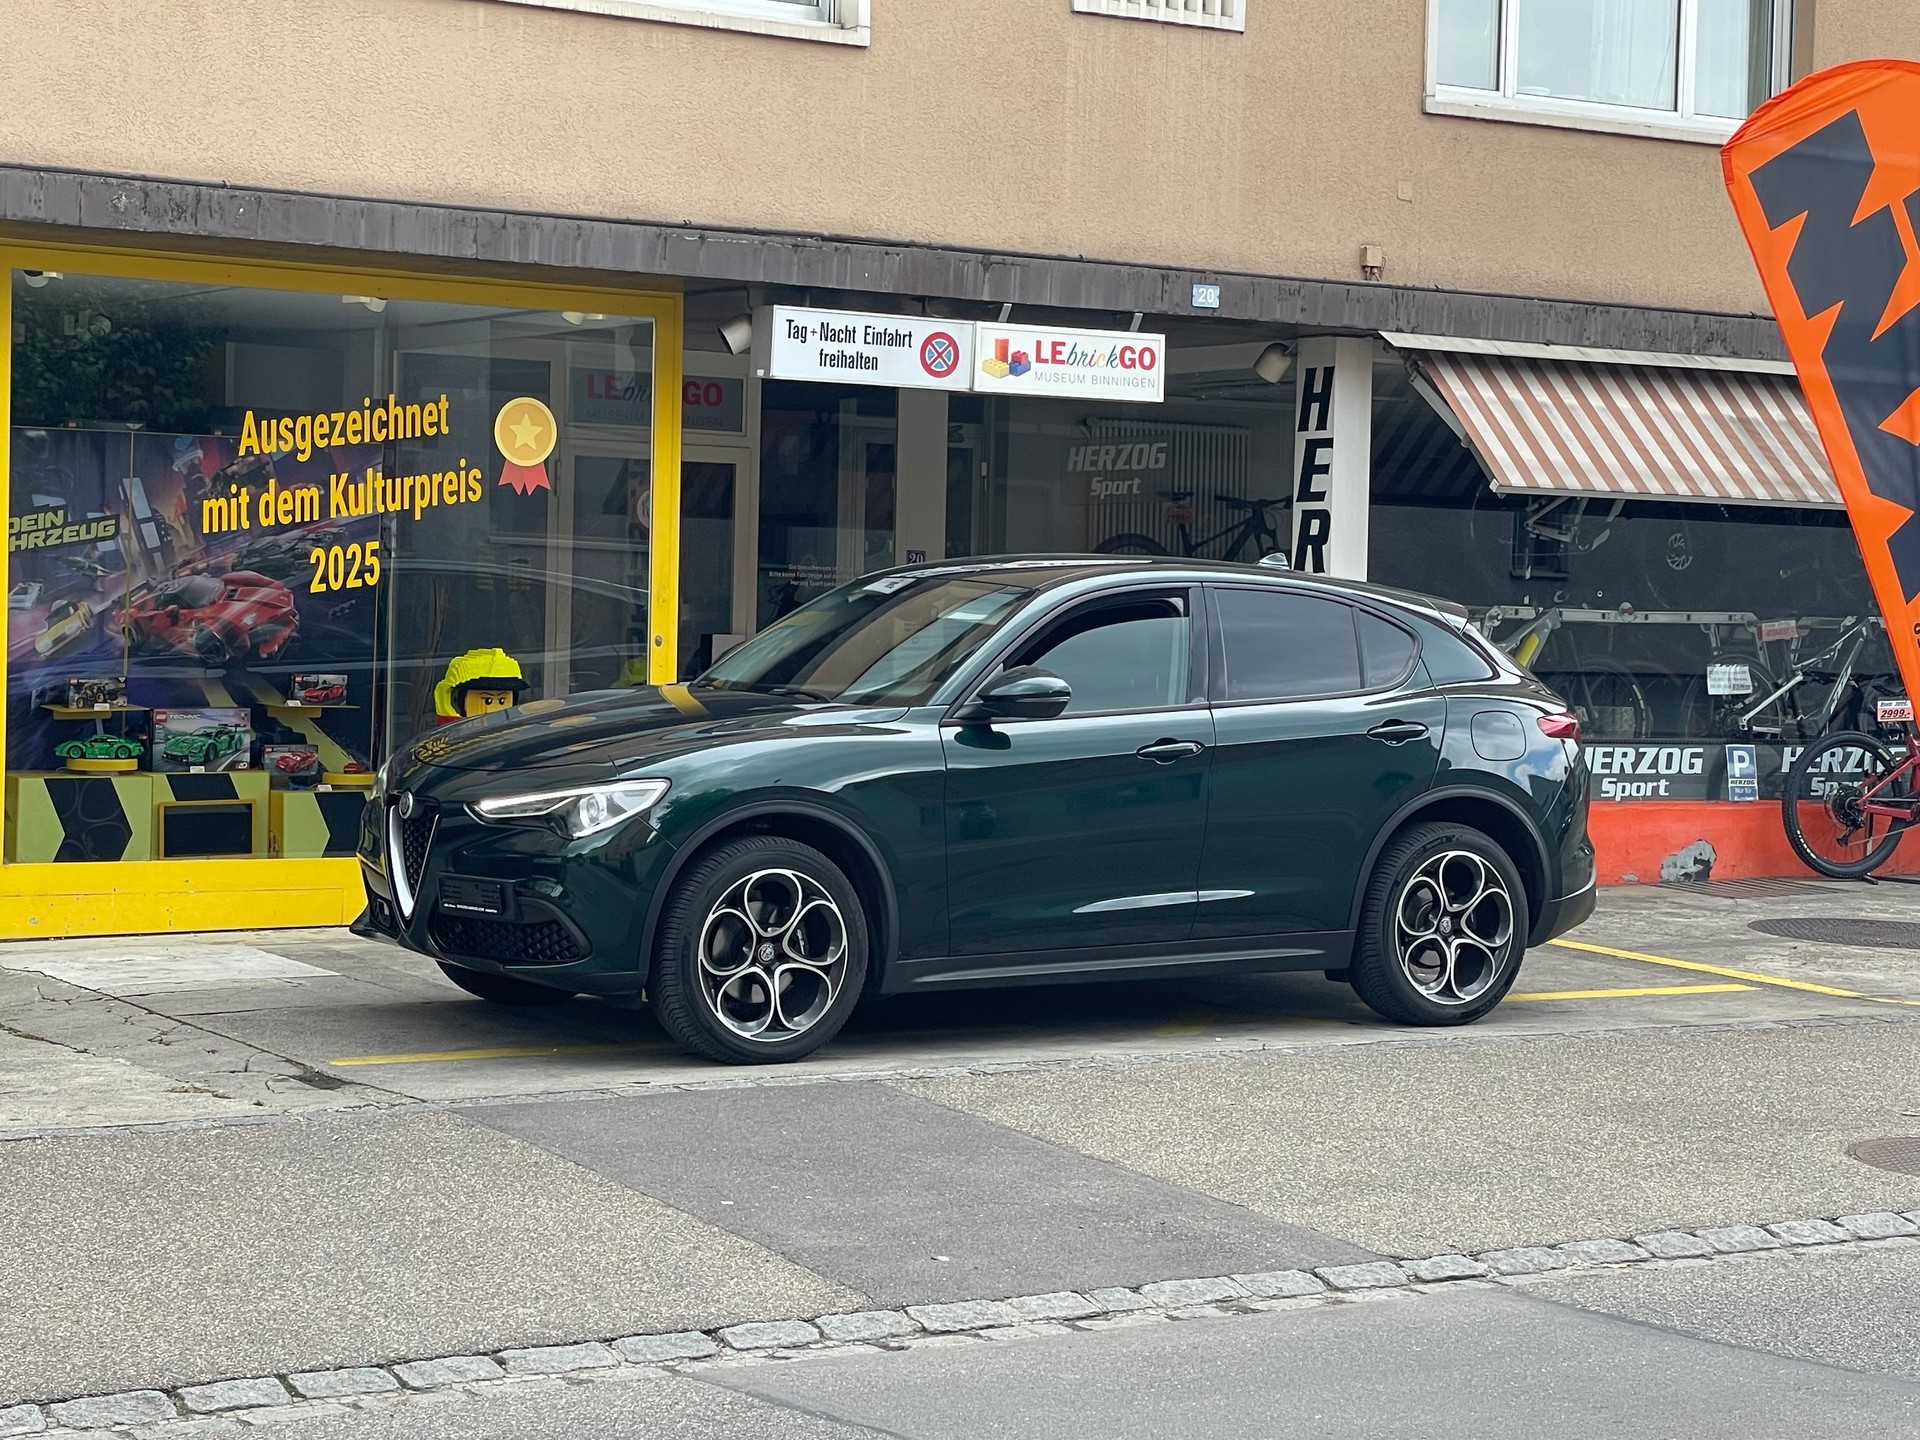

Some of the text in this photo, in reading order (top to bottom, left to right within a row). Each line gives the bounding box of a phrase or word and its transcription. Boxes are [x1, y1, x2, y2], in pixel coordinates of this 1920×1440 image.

[1197, 287, 1215, 303] 20
[864, 325, 913, 348] Einfahrt
[819, 348, 878, 371] freihalten
[1035, 339, 1156, 371] LEbrickGO
[1034, 371, 1156, 388] MUSEUM BINNINGEN
[238, 393, 449, 462] Ausgezeichnet
[1067, 442, 1168, 472] HERZOG
[202, 458, 483, 534] mit dem Kulturpreis
[1090, 477, 1141, 500] Sport
[310, 541, 381, 593] 2025
[909, 552, 924, 564] 20
[1881, 709, 1911, 718] 2999.-
[1733, 750, 1750, 777] P
[1781, 747, 1907, 773] HRZ
[1601, 777, 1670, 801] Sport
